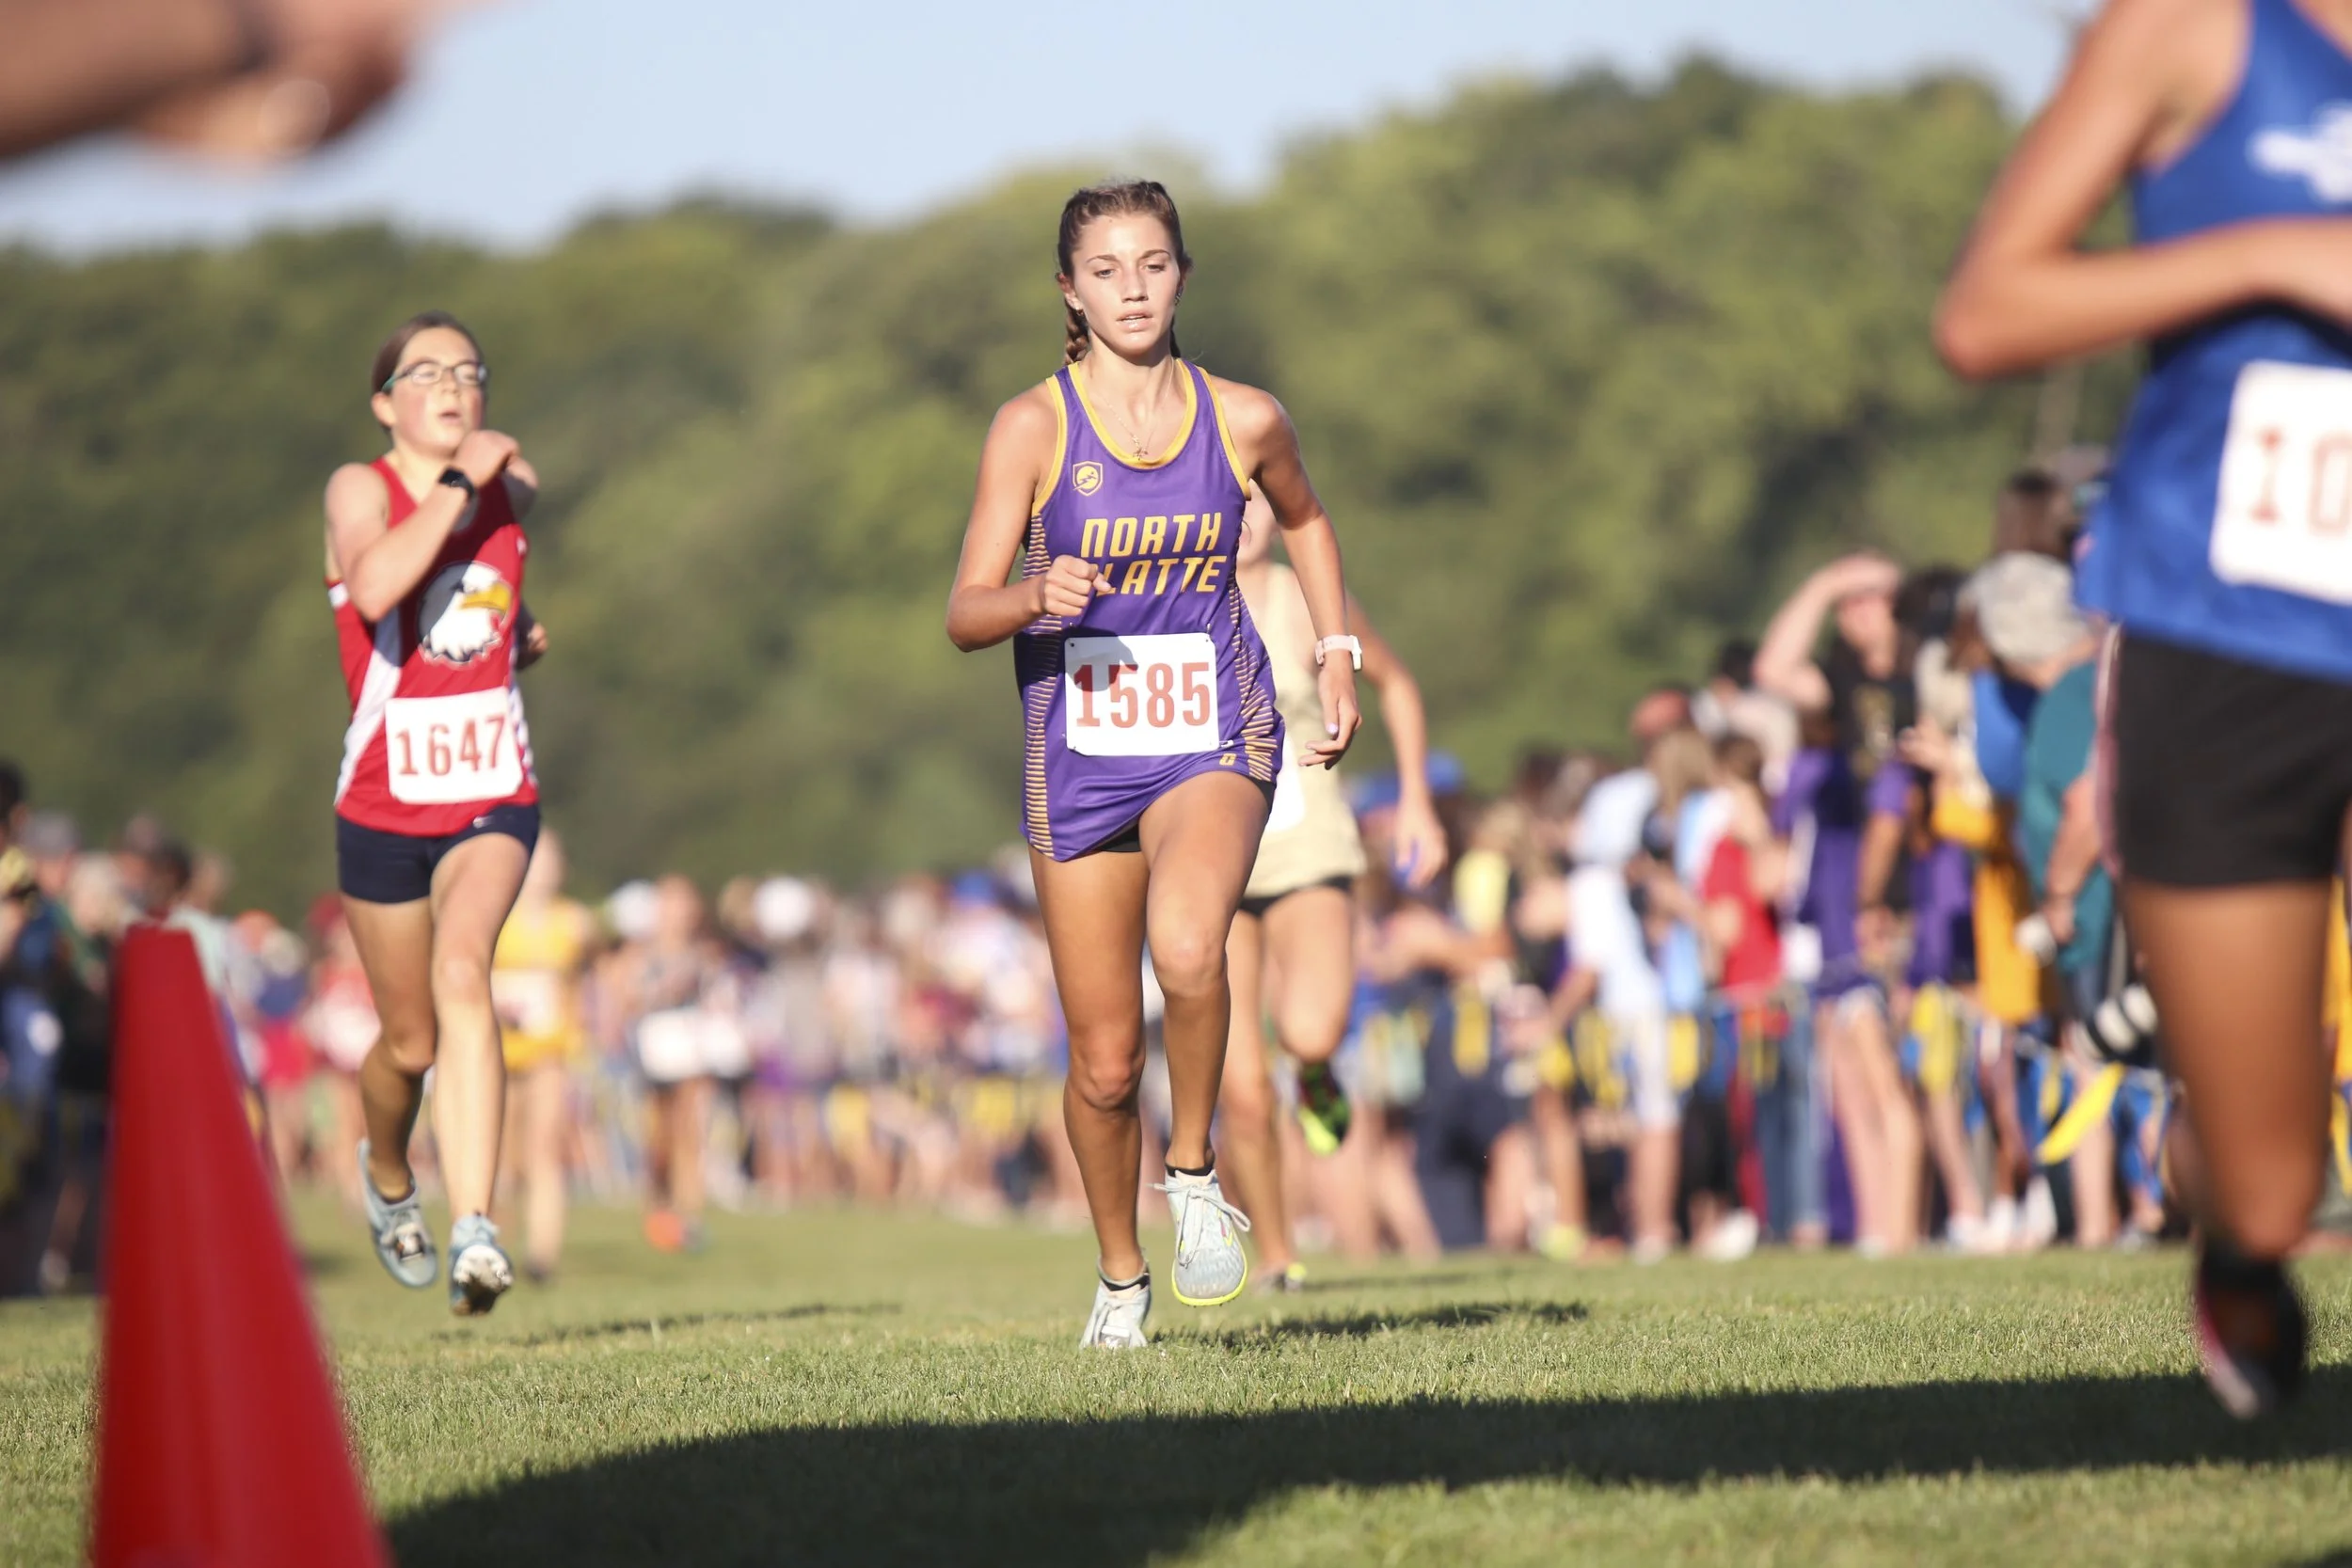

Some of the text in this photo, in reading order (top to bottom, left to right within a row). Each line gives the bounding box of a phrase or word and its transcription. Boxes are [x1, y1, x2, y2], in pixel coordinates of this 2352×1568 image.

[1081, 513, 1222, 558] NORTH
[1091, 555, 1228, 597] LATTE
[1073, 661, 1212, 729] 1585
[394, 713, 506, 777] 1647
